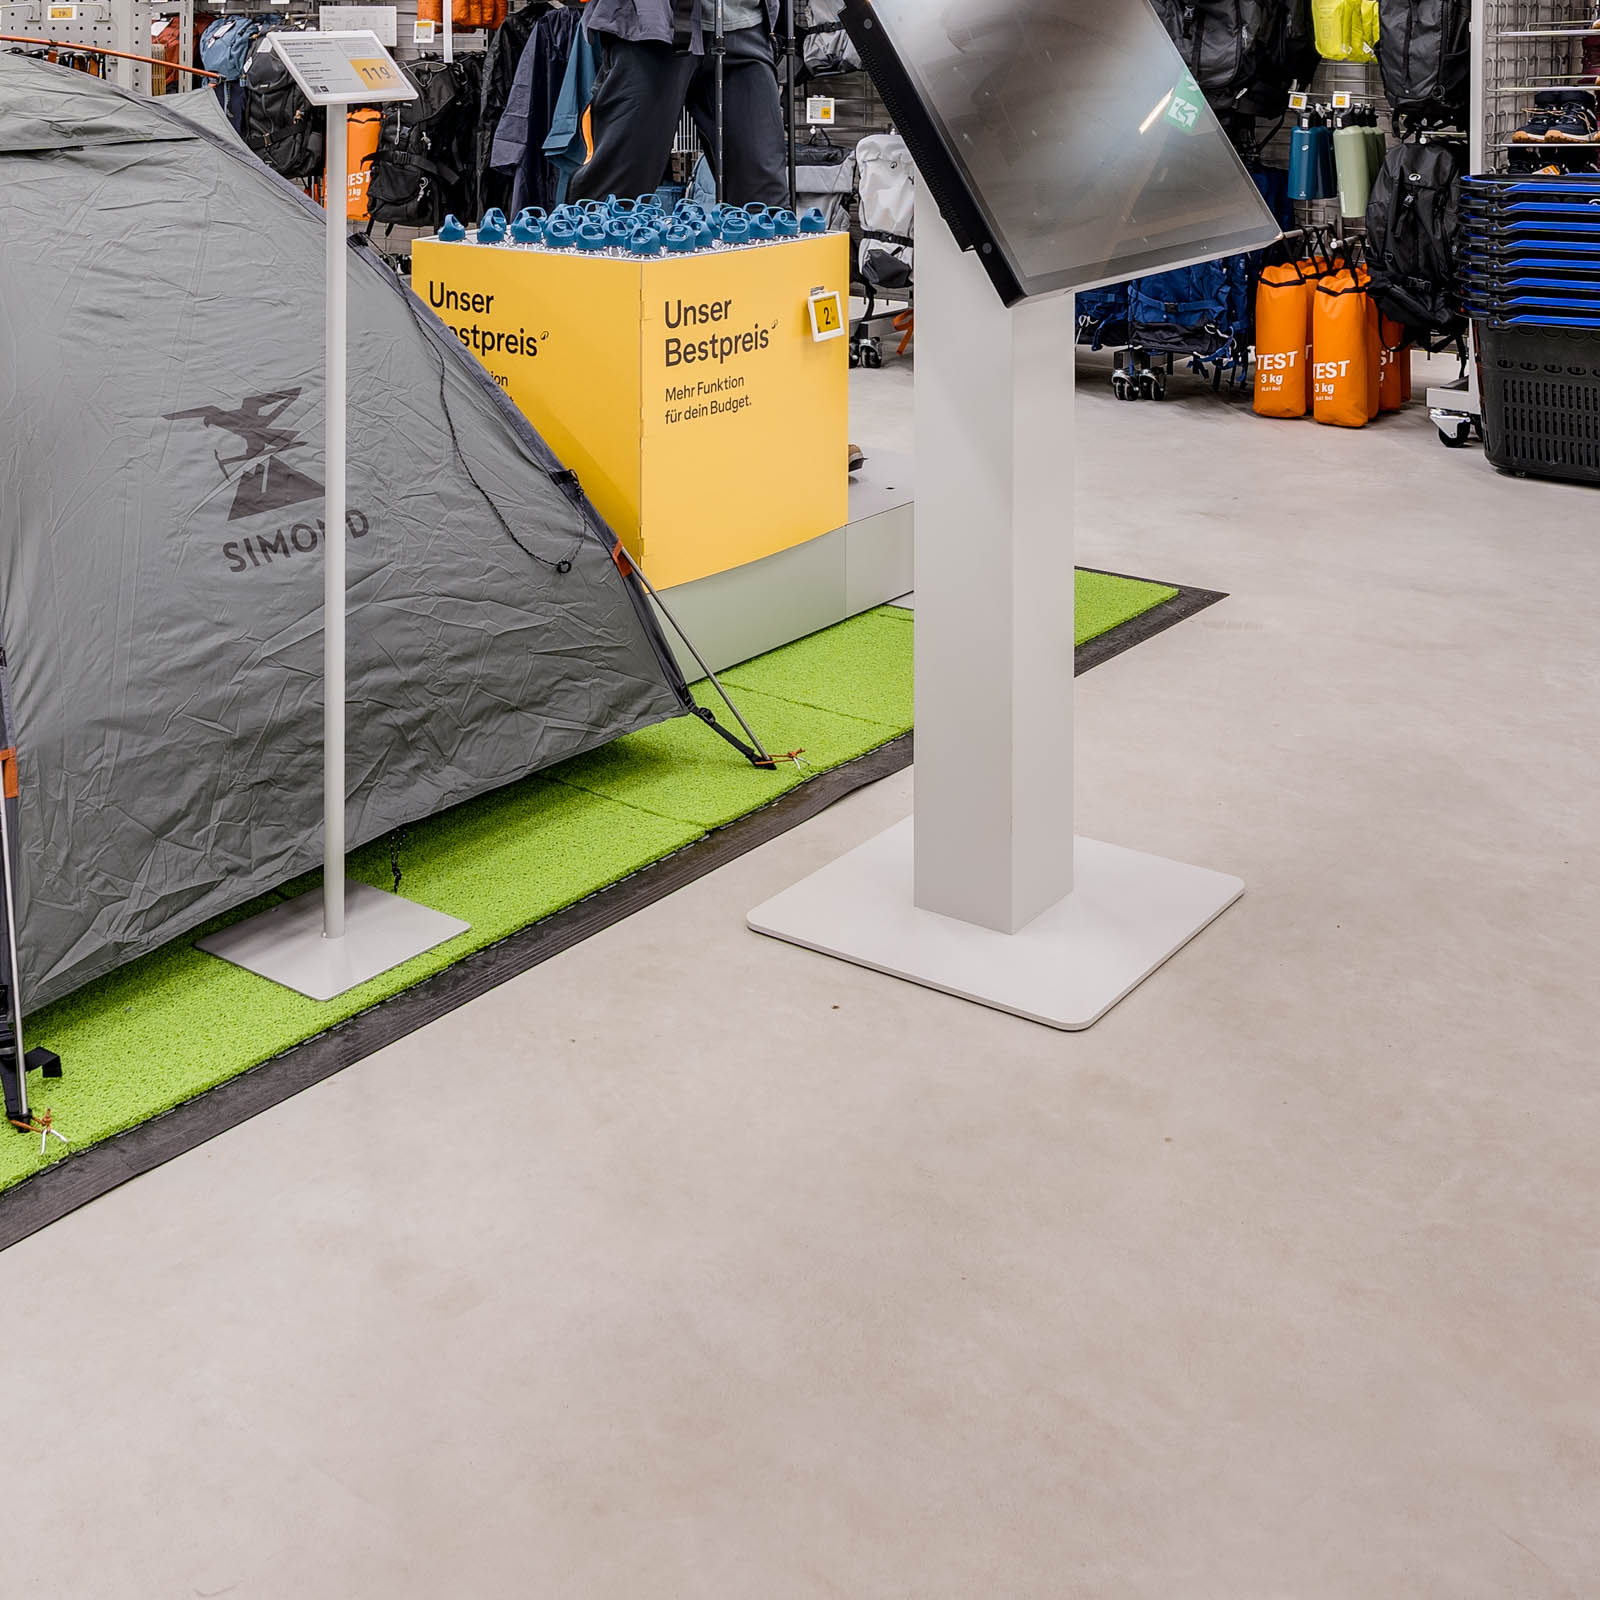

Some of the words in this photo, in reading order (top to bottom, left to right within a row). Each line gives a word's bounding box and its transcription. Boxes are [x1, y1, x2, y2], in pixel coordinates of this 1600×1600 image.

[362, 66, 391, 81] 119
[347, 170, 371, 187] EST
[429, 280, 494, 315] Unser
[664, 297, 732, 329] Unser
[665, 324, 770, 368] Bestpreis
[1256, 351, 1298, 371] TEST
[665, 383, 695, 403] Mehr
[697, 375, 745, 397] Funktion
[1261, 374, 1267, 383] 3
[1269, 374, 1283, 385] kg
[1314, 383, 1319, 392] 3
[1321, 383, 1334, 394] kg
[665, 408, 682, 425] für
[684, 402, 708, 419] dein
[710, 395, 752, 416] Budget.
